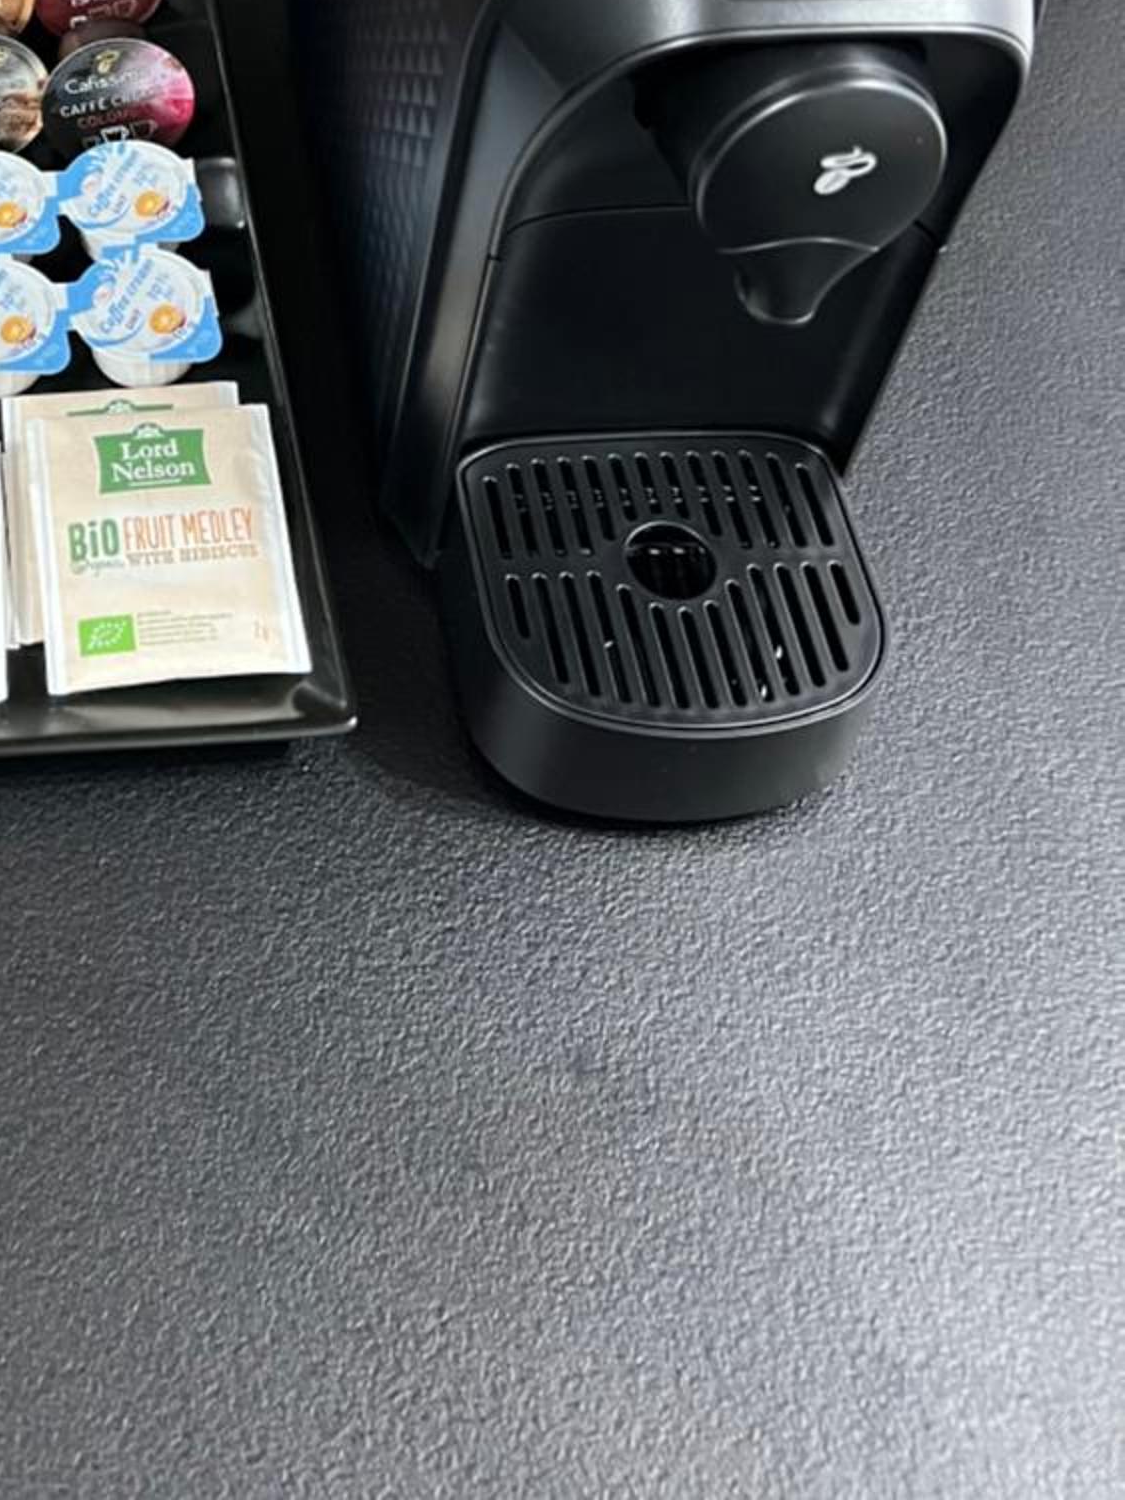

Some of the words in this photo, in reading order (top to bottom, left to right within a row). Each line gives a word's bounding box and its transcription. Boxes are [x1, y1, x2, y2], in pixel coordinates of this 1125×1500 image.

[119, 438, 179, 461] Lord
[111, 459, 196, 483] Nelson
[122, 513, 175, 551] FRUIT
[180, 506, 252, 547] MEDLEY
